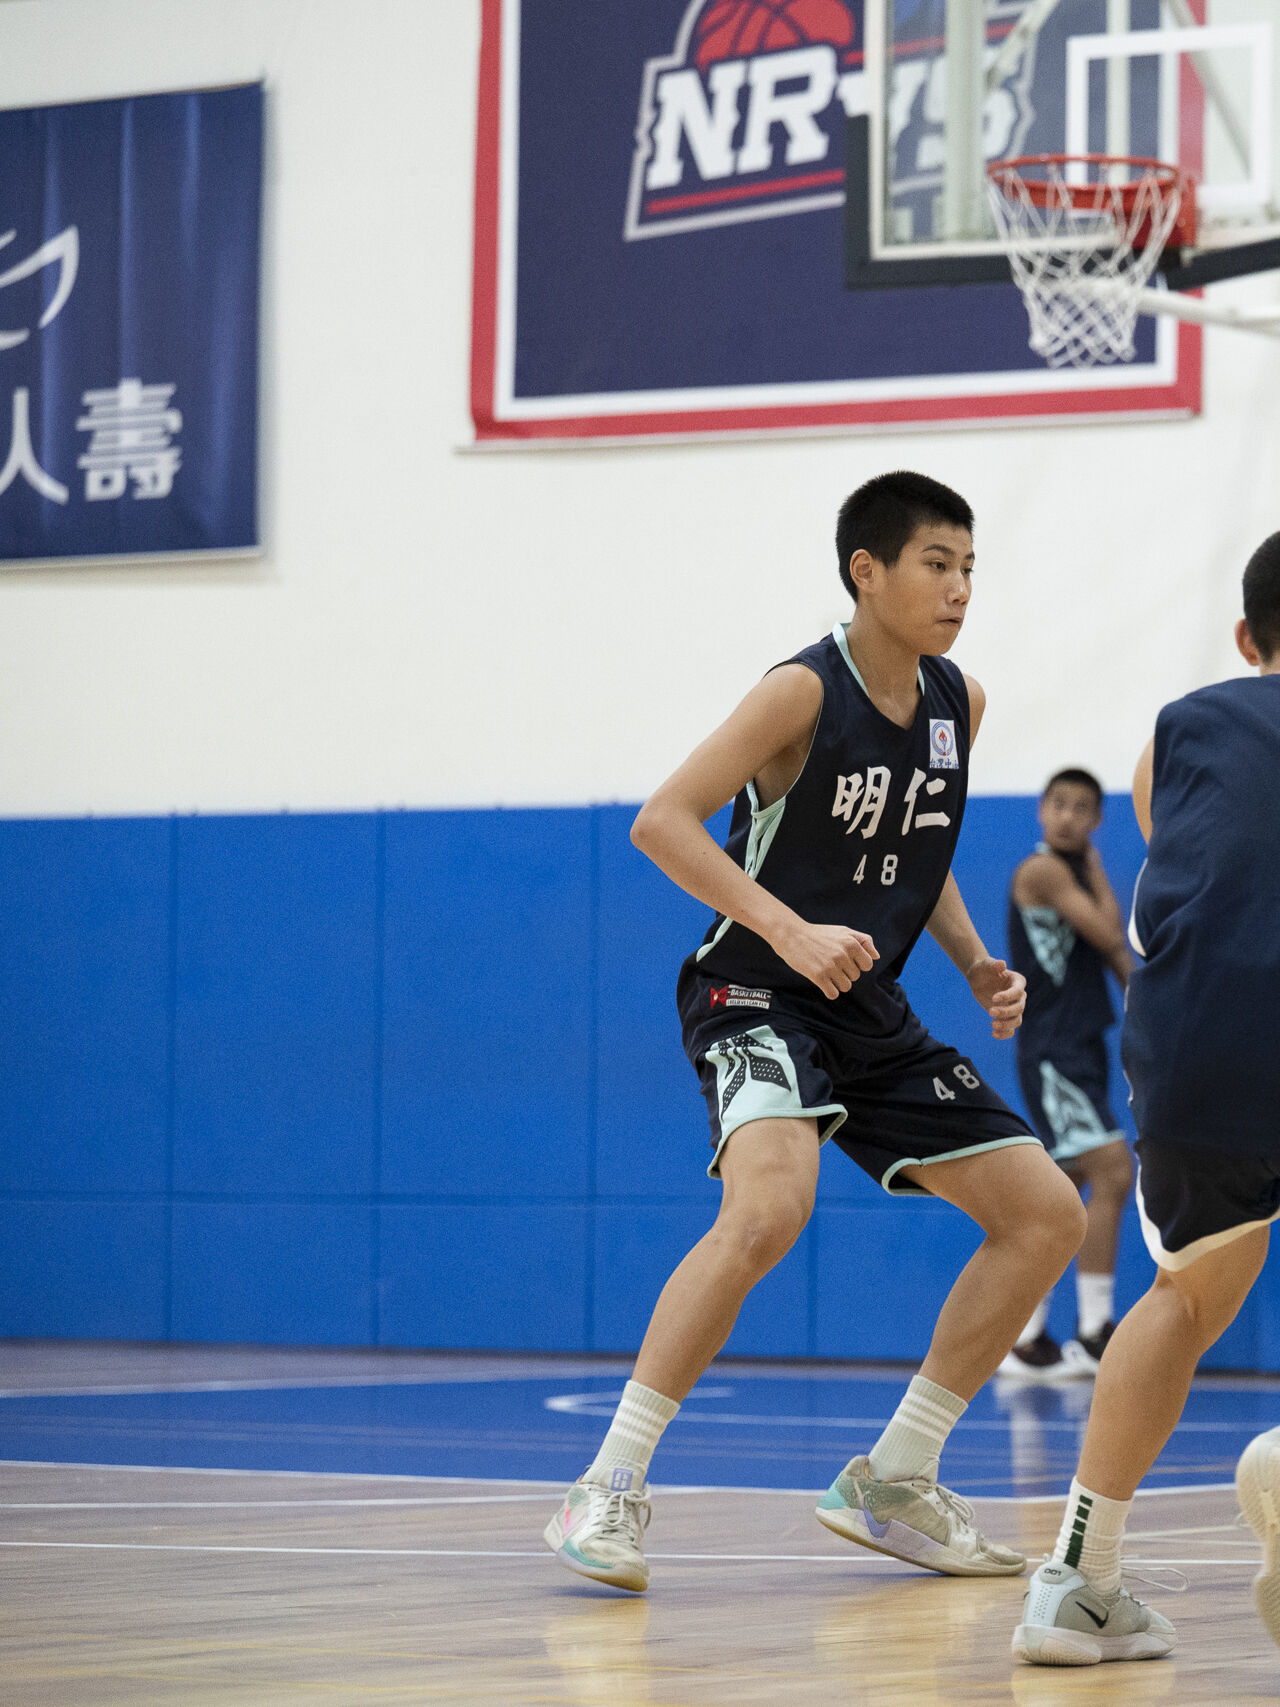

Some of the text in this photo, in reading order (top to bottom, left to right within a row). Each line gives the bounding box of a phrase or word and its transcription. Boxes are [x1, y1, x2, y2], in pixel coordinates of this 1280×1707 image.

[0, 377, 182, 503] 人壽
[832, 765, 951, 839] 明仁
[853, 854, 899, 886] 48
[932, 1064, 980, 1100] 48
